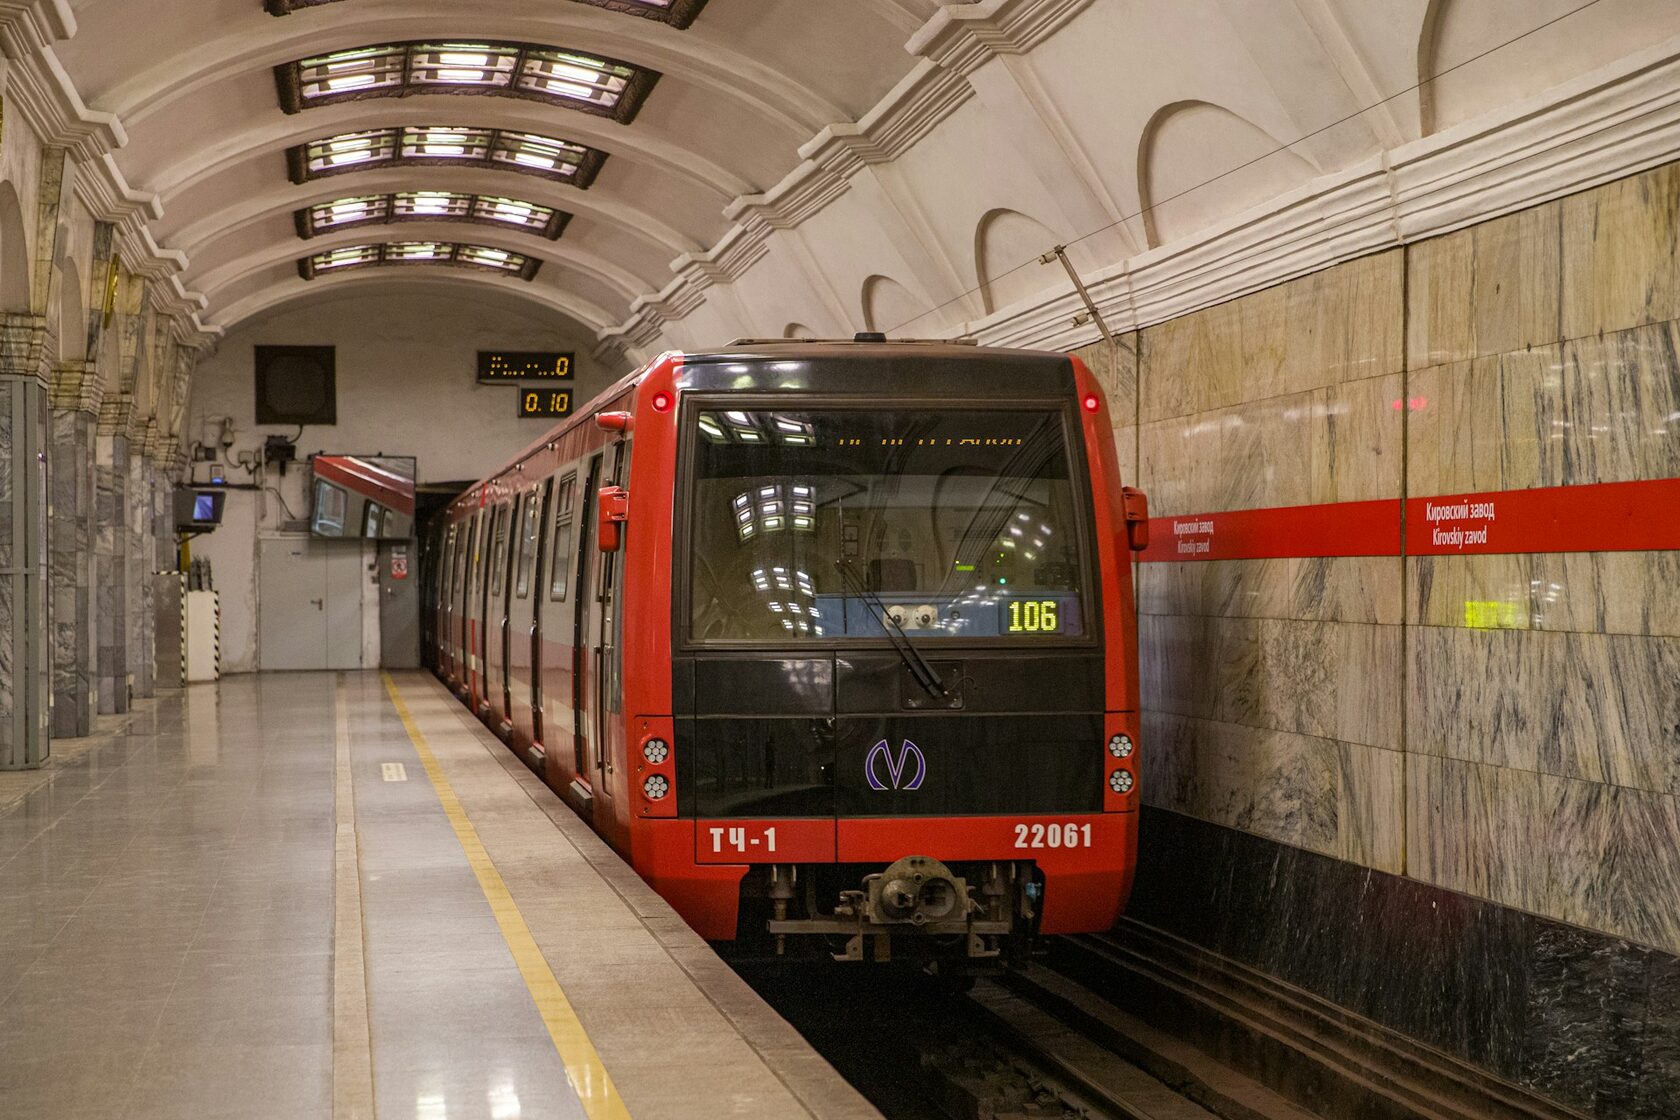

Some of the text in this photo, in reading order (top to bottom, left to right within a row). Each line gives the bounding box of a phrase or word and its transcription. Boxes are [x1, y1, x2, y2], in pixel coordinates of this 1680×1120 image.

[1426, 499, 1496, 526] Кировский завод
[1432, 525, 1487, 550] Kirovskiy zavod
[1009, 601, 1057, 632] 106
[709, 827, 776, 853] ТЧ-1
[1014, 822, 1092, 849] 22061
